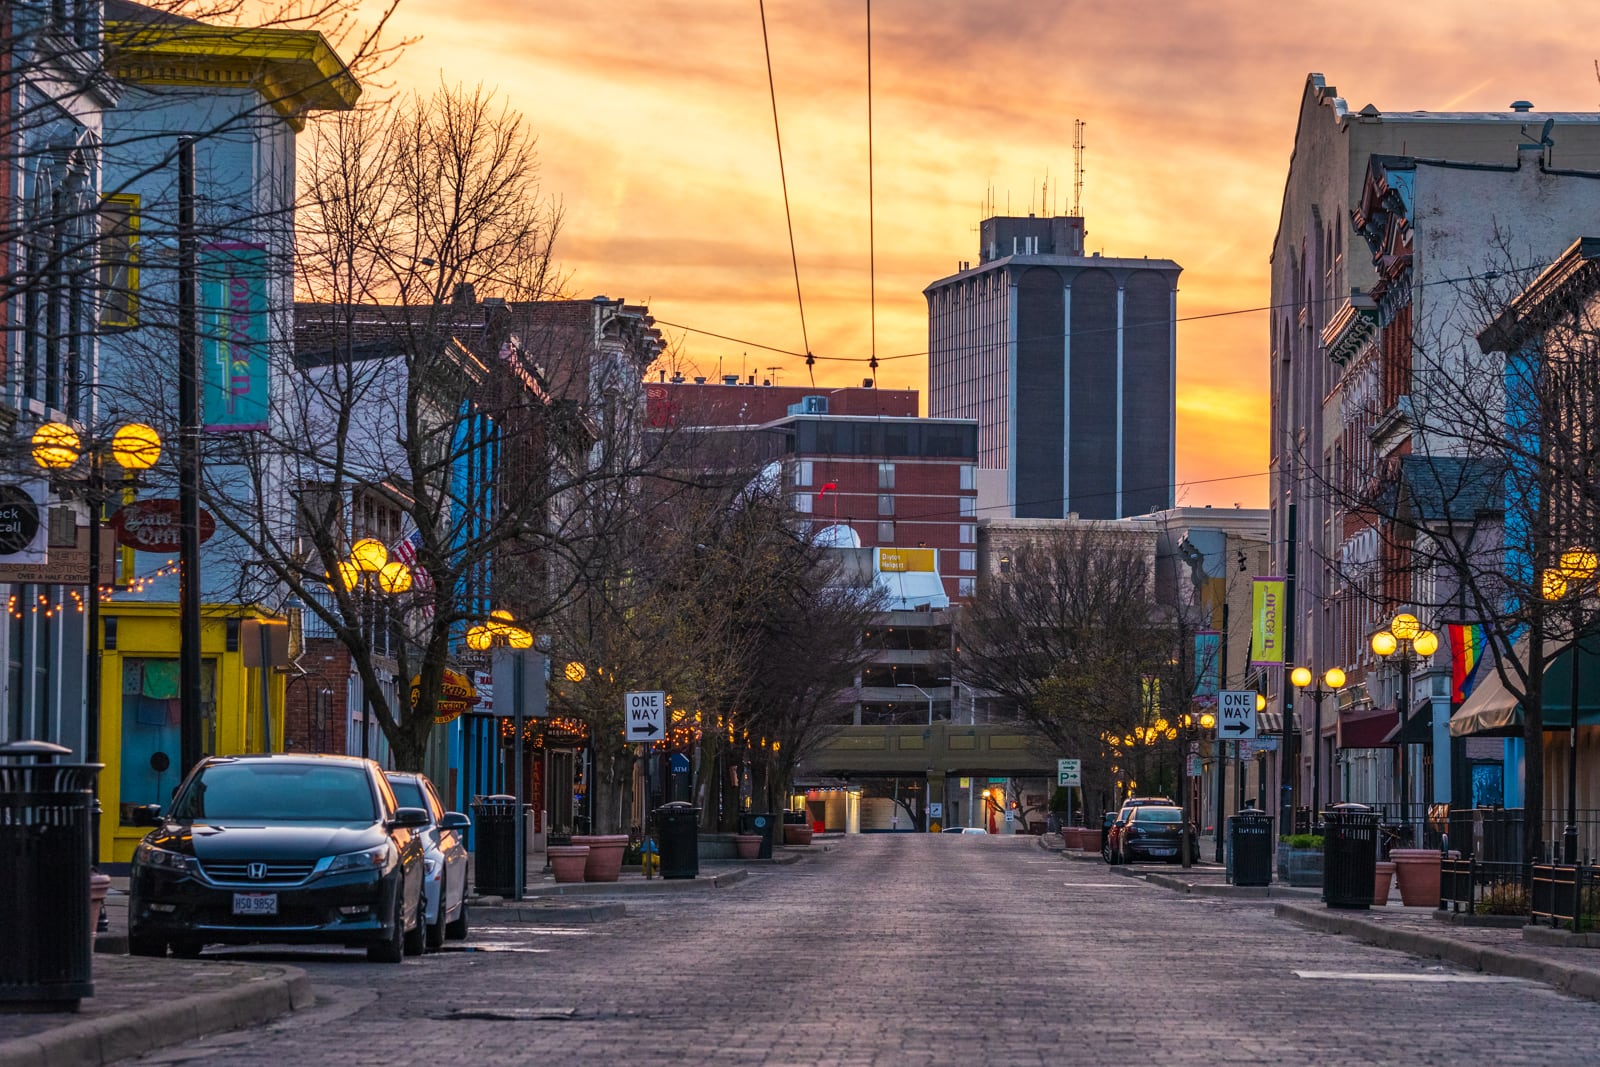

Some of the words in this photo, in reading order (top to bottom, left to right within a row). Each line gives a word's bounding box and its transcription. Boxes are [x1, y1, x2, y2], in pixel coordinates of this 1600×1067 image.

[632, 696, 658, 707] ONE
[1224, 695, 1250, 706] ONE
[632, 709, 659, 720] WAY
[1224, 708, 1251, 719] WAY
